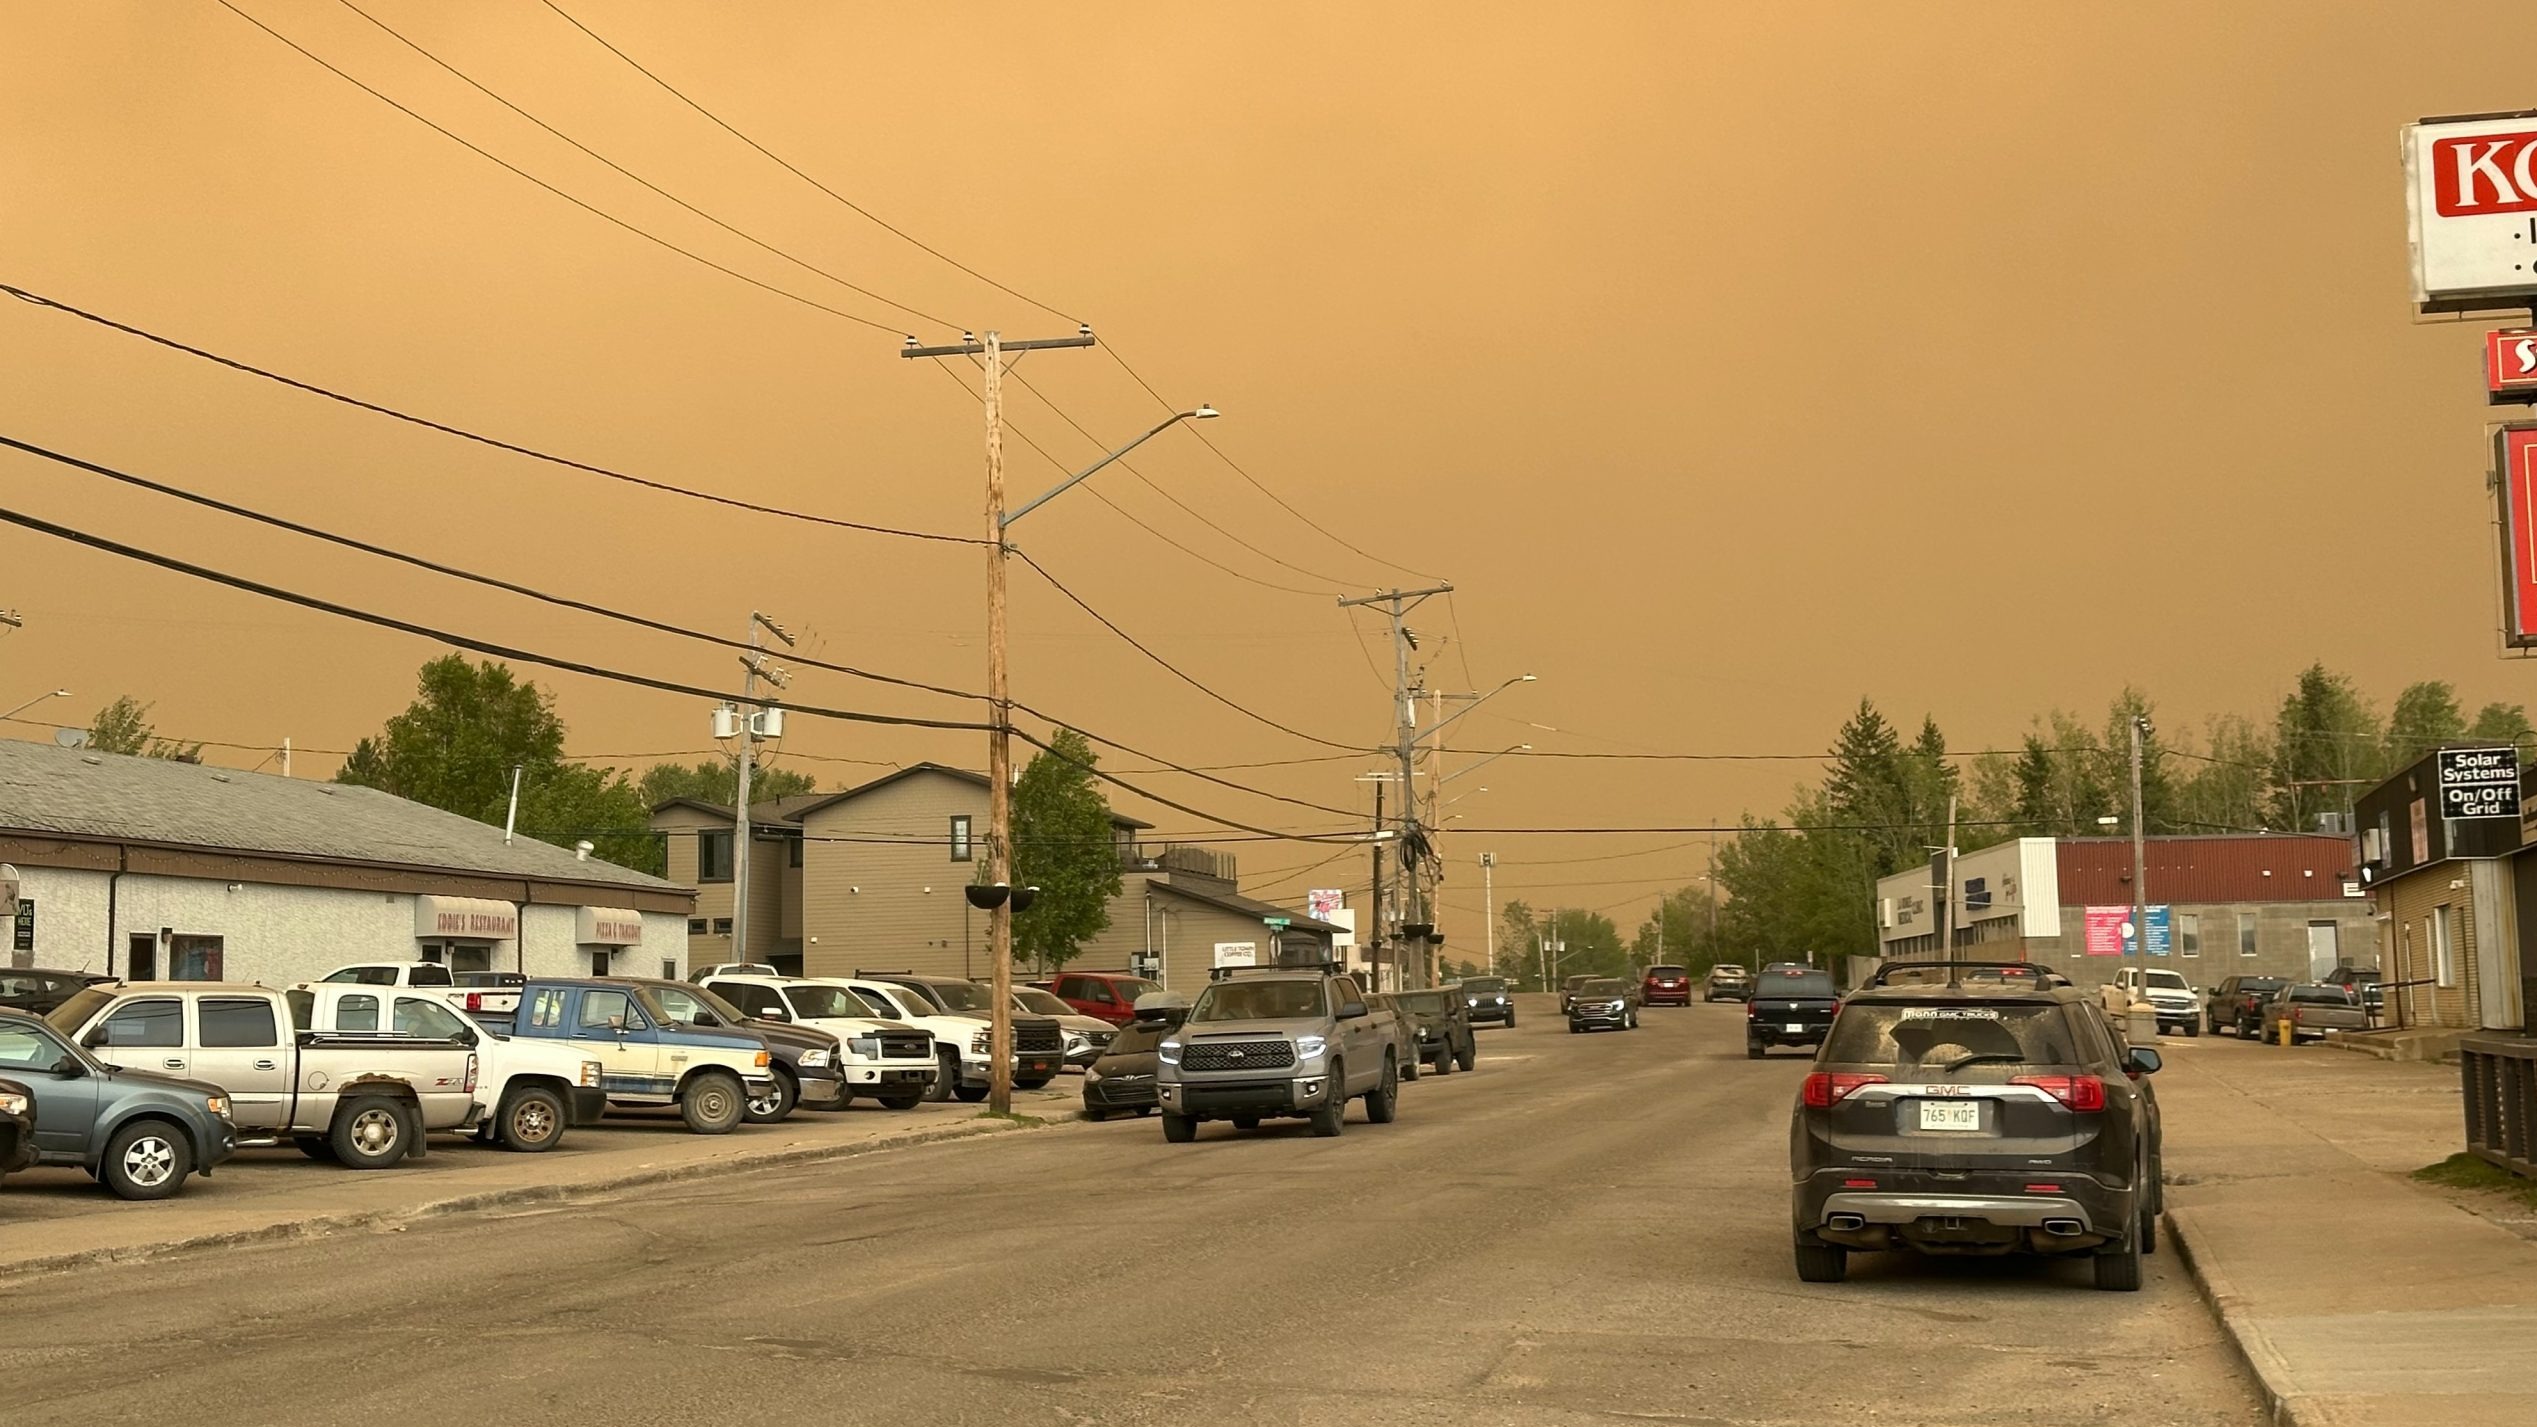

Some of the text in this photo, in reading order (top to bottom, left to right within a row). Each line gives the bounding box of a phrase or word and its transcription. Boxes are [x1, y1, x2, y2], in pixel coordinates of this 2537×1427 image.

[2455, 753, 2501, 768] Solar
[2443, 767, 2515, 782] Systems
[2449, 787, 2512, 803] On/Off
[2462, 801, 2500, 815] Grid
[438, 912, 515, 934] EDDIE'S RESTAURANT
[1926, 1085, 1971, 1096] GMC
[1923, 1109, 1946, 1122] 765
